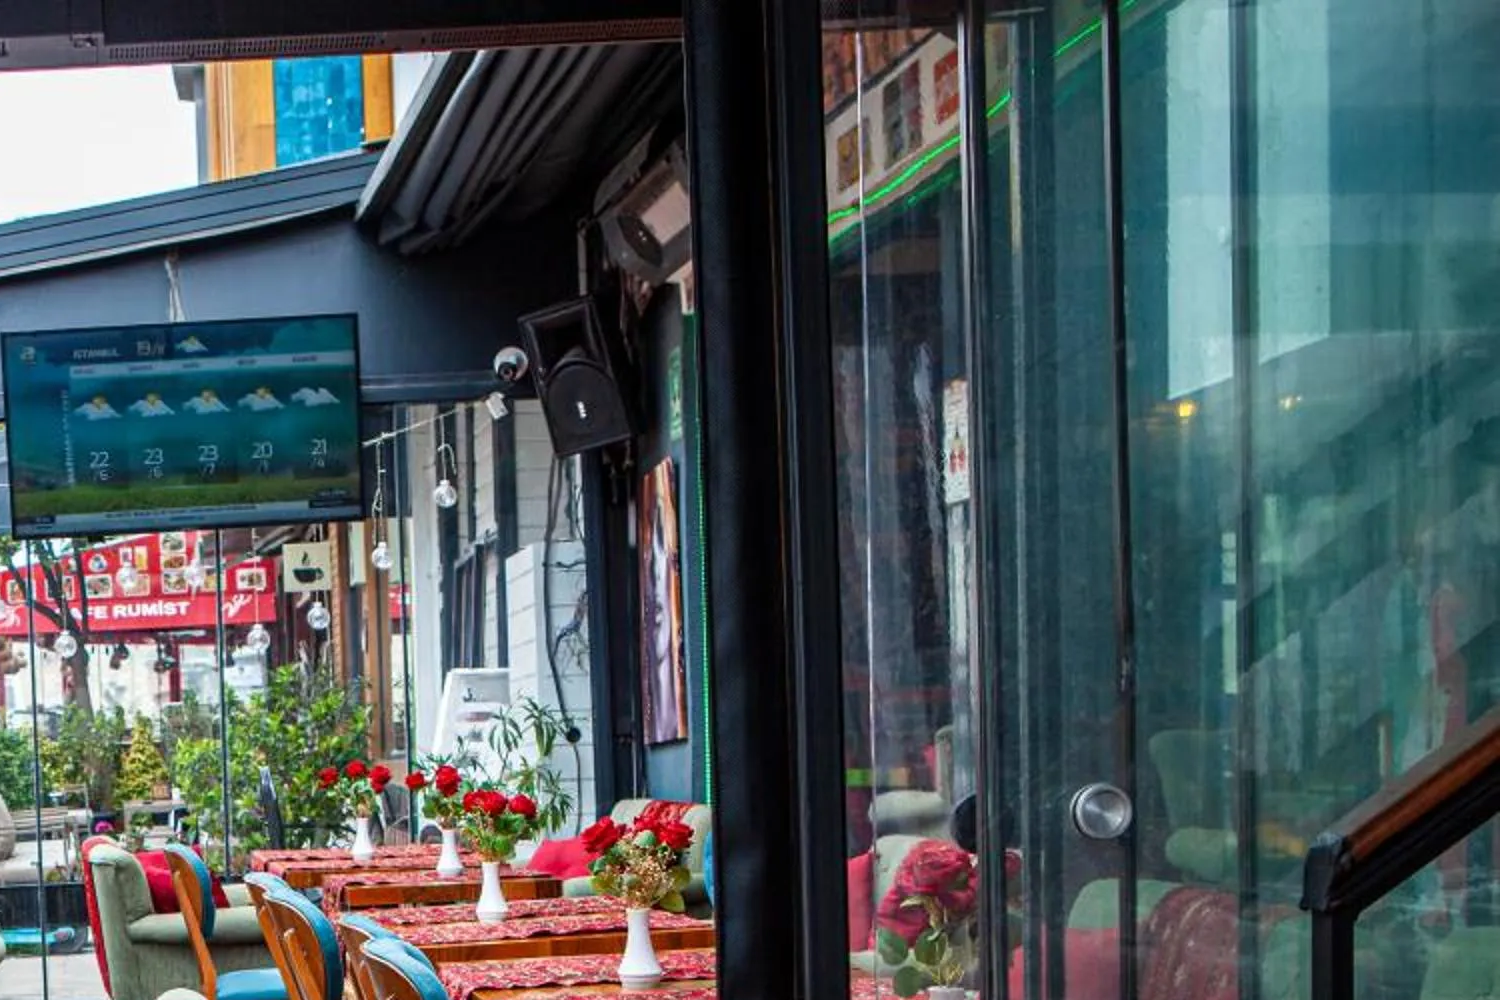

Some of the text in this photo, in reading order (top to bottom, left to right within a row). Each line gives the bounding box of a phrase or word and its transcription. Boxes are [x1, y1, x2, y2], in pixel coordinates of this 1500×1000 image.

[90, 451, 110, 469] 22
[198, 445, 219, 462] 23
[252, 440, 274, 459] 20
